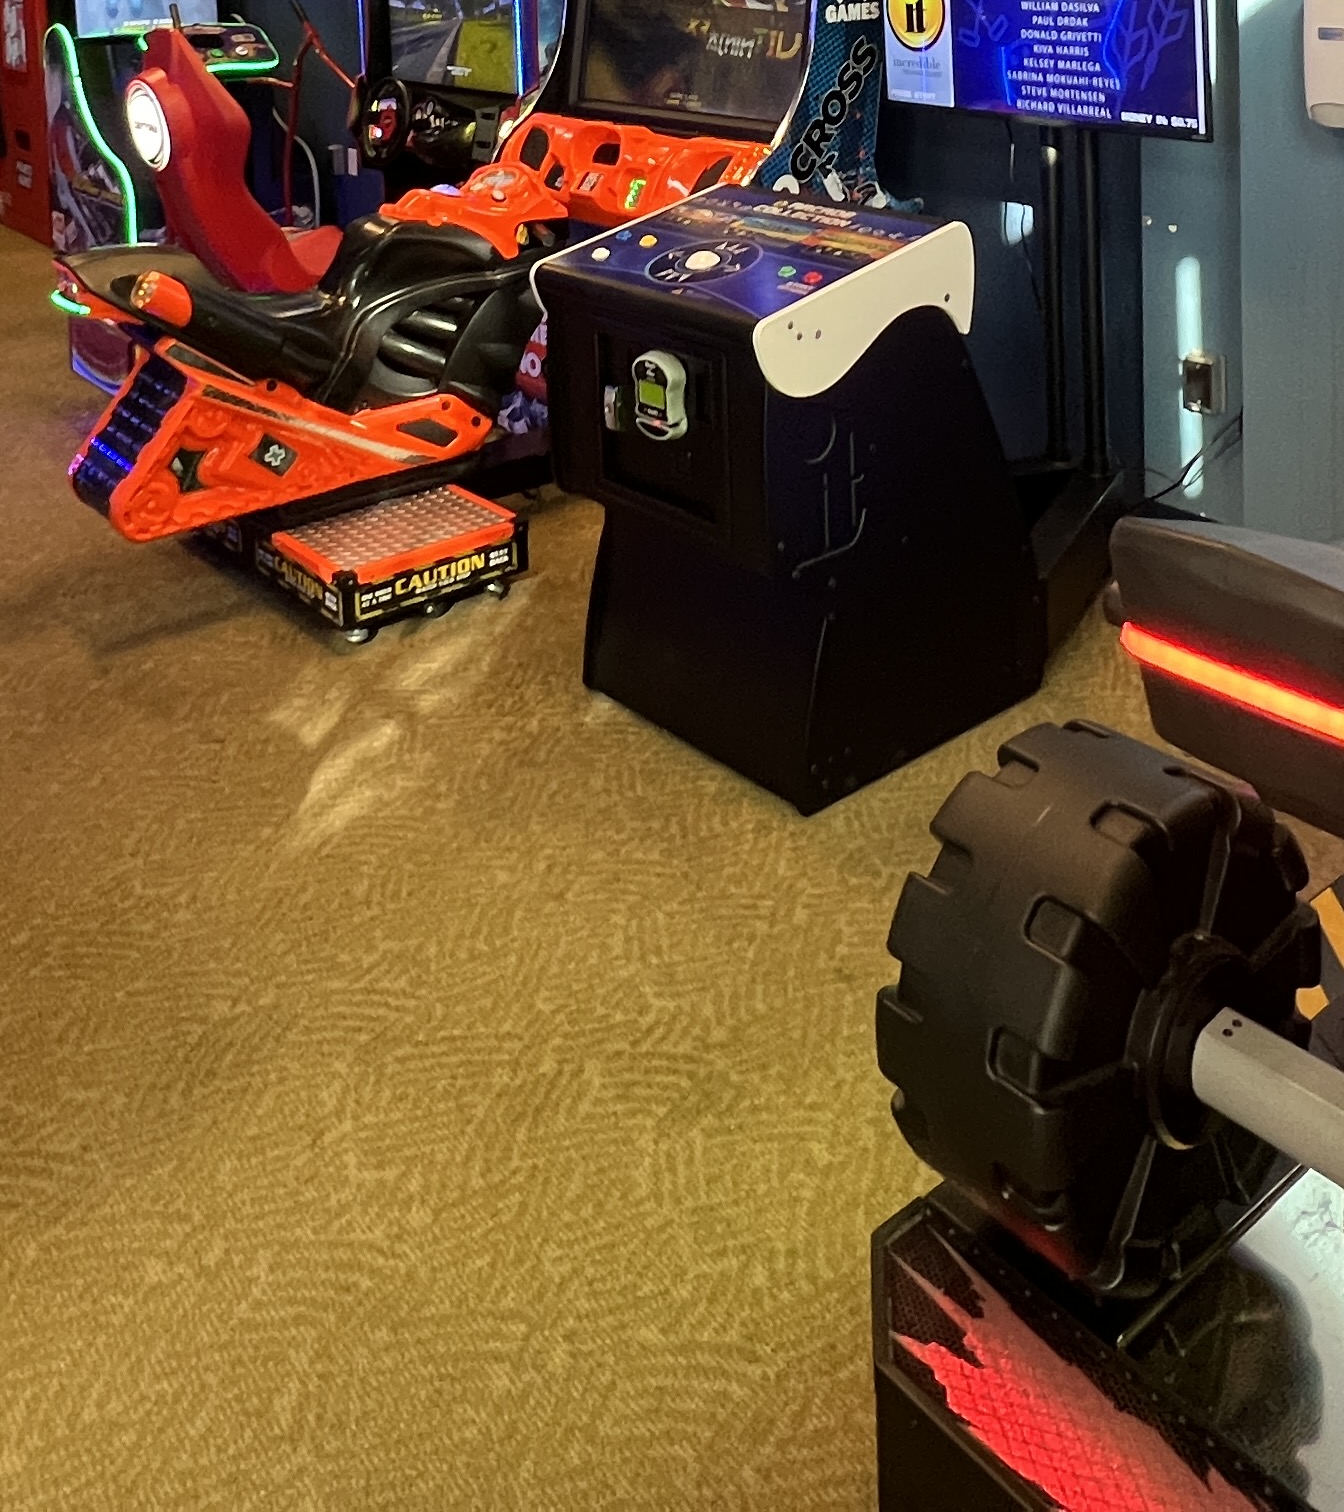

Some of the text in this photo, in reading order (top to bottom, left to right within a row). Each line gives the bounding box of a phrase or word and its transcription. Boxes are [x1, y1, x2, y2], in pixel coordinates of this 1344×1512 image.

[825, 1, 880, 24] GAMES
[1020, 1, 1100, 13] WILLIAM DASILVA
[1032, 15, 1054, 26] PAUL
[1020, 29, 1102, 43] DONALD GRIVETTI
[1033, 44, 1090, 57] KIVA HARRIS
[893, 55, 941, 69] incredble
[1023, 57, 1055, 69] KELSEY
[1007, 70, 1044, 83] SABRINA
[1021, 85, 1106, 103] STEVE MORTENSEN
[1016, 99, 1055, 113] RICHARD
[395, 552, 485, 596] CAUTION
